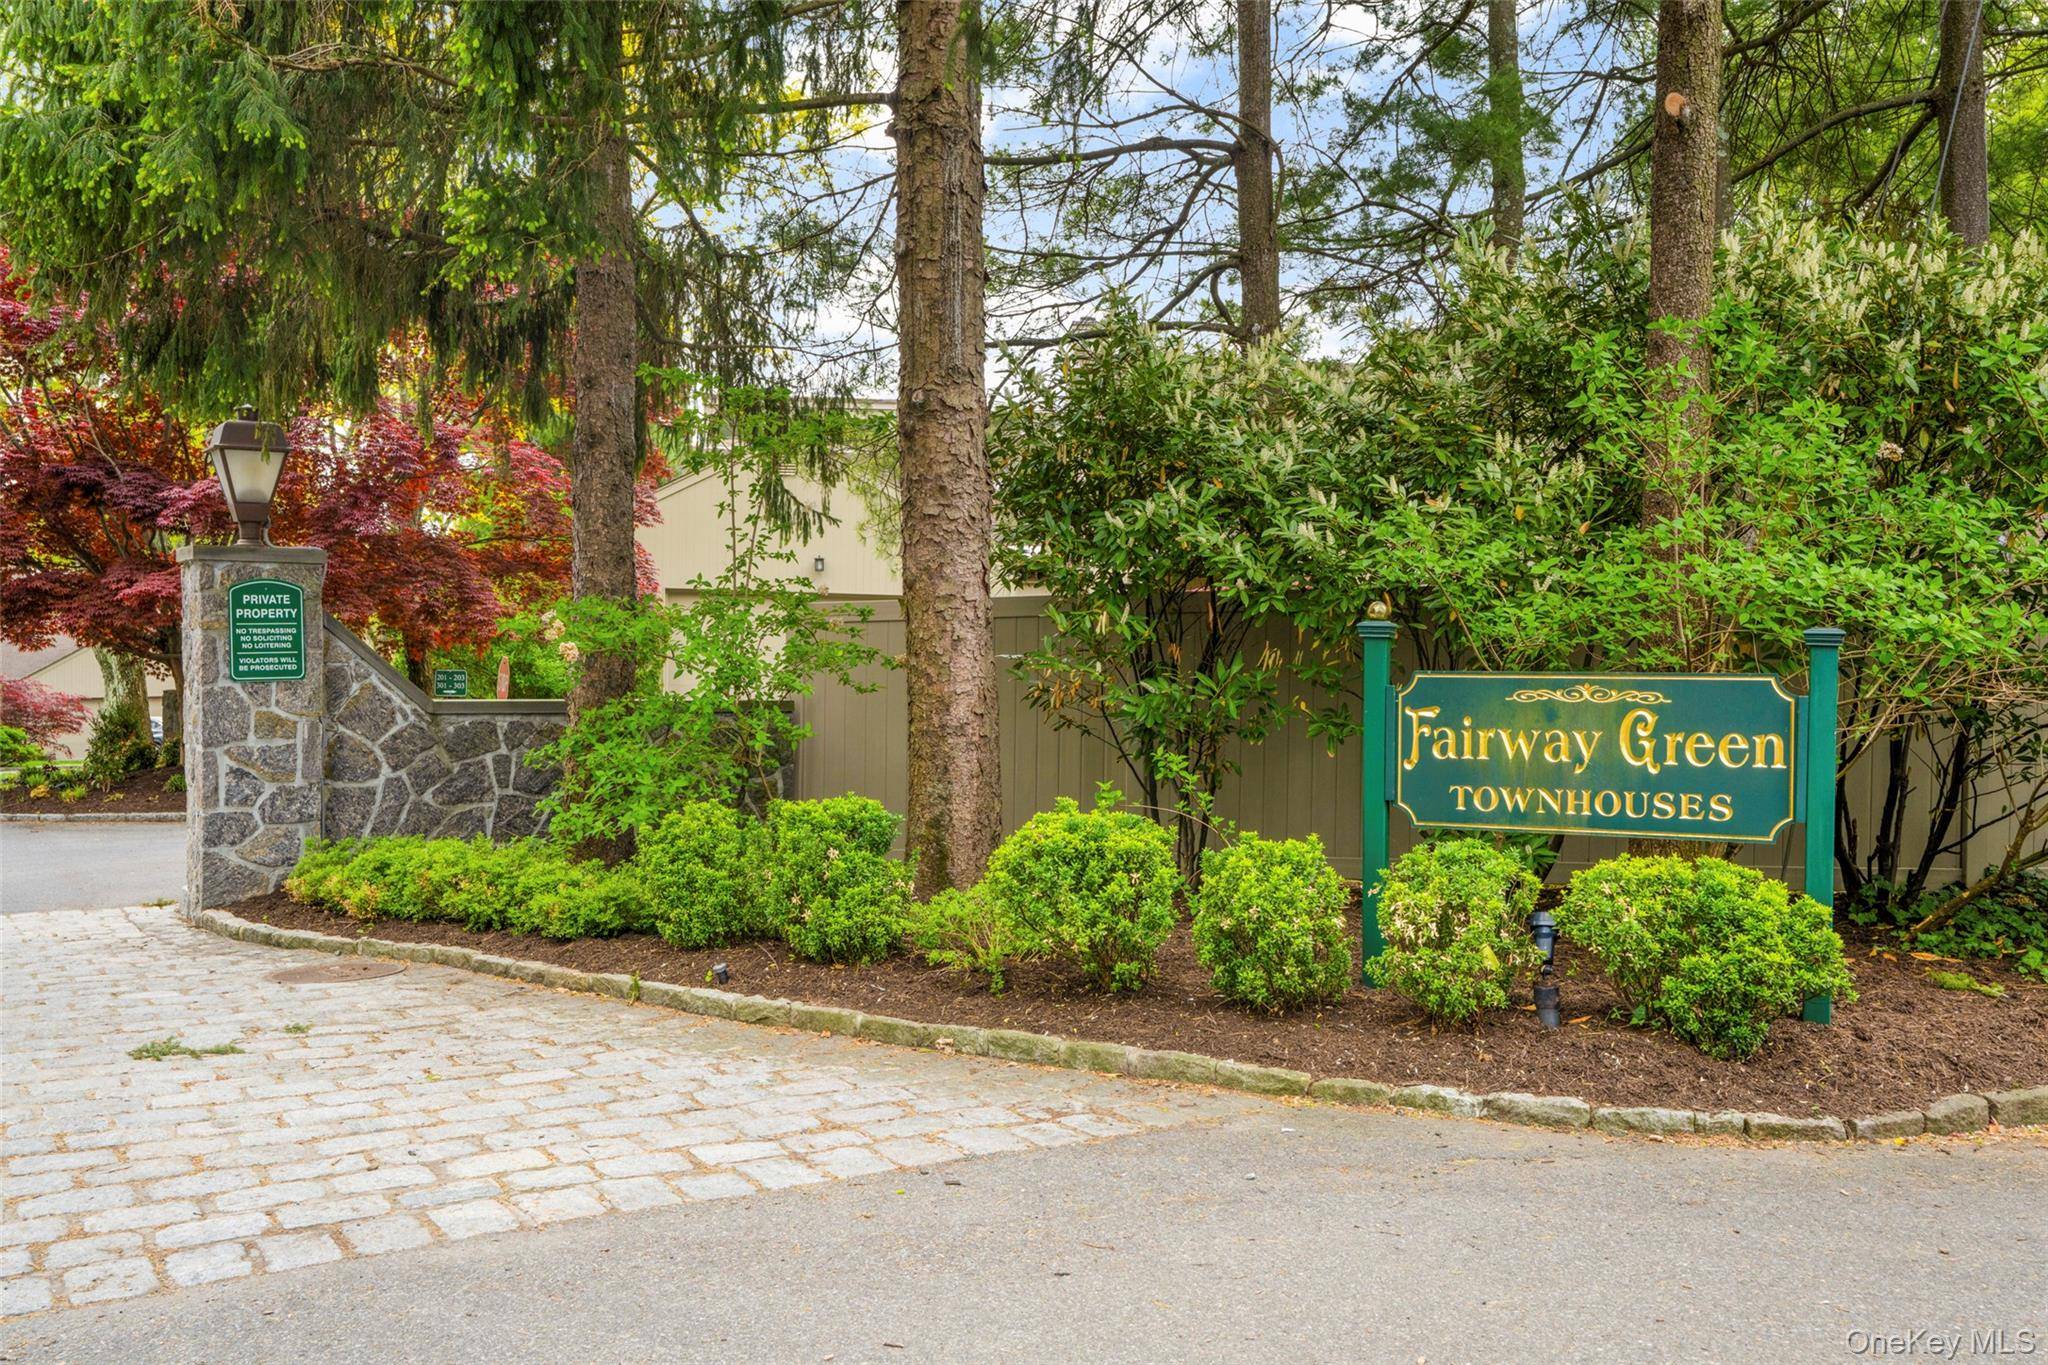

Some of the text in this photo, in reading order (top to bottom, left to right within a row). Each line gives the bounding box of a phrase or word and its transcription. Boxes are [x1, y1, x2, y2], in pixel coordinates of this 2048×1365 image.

[243, 594, 291, 604] PRIVATE
[236, 608, 298, 619] PROPERTY
[1402, 704, 1788, 775] Fairway Green
[1448, 783, 1734, 823] TOWNHOUSES
